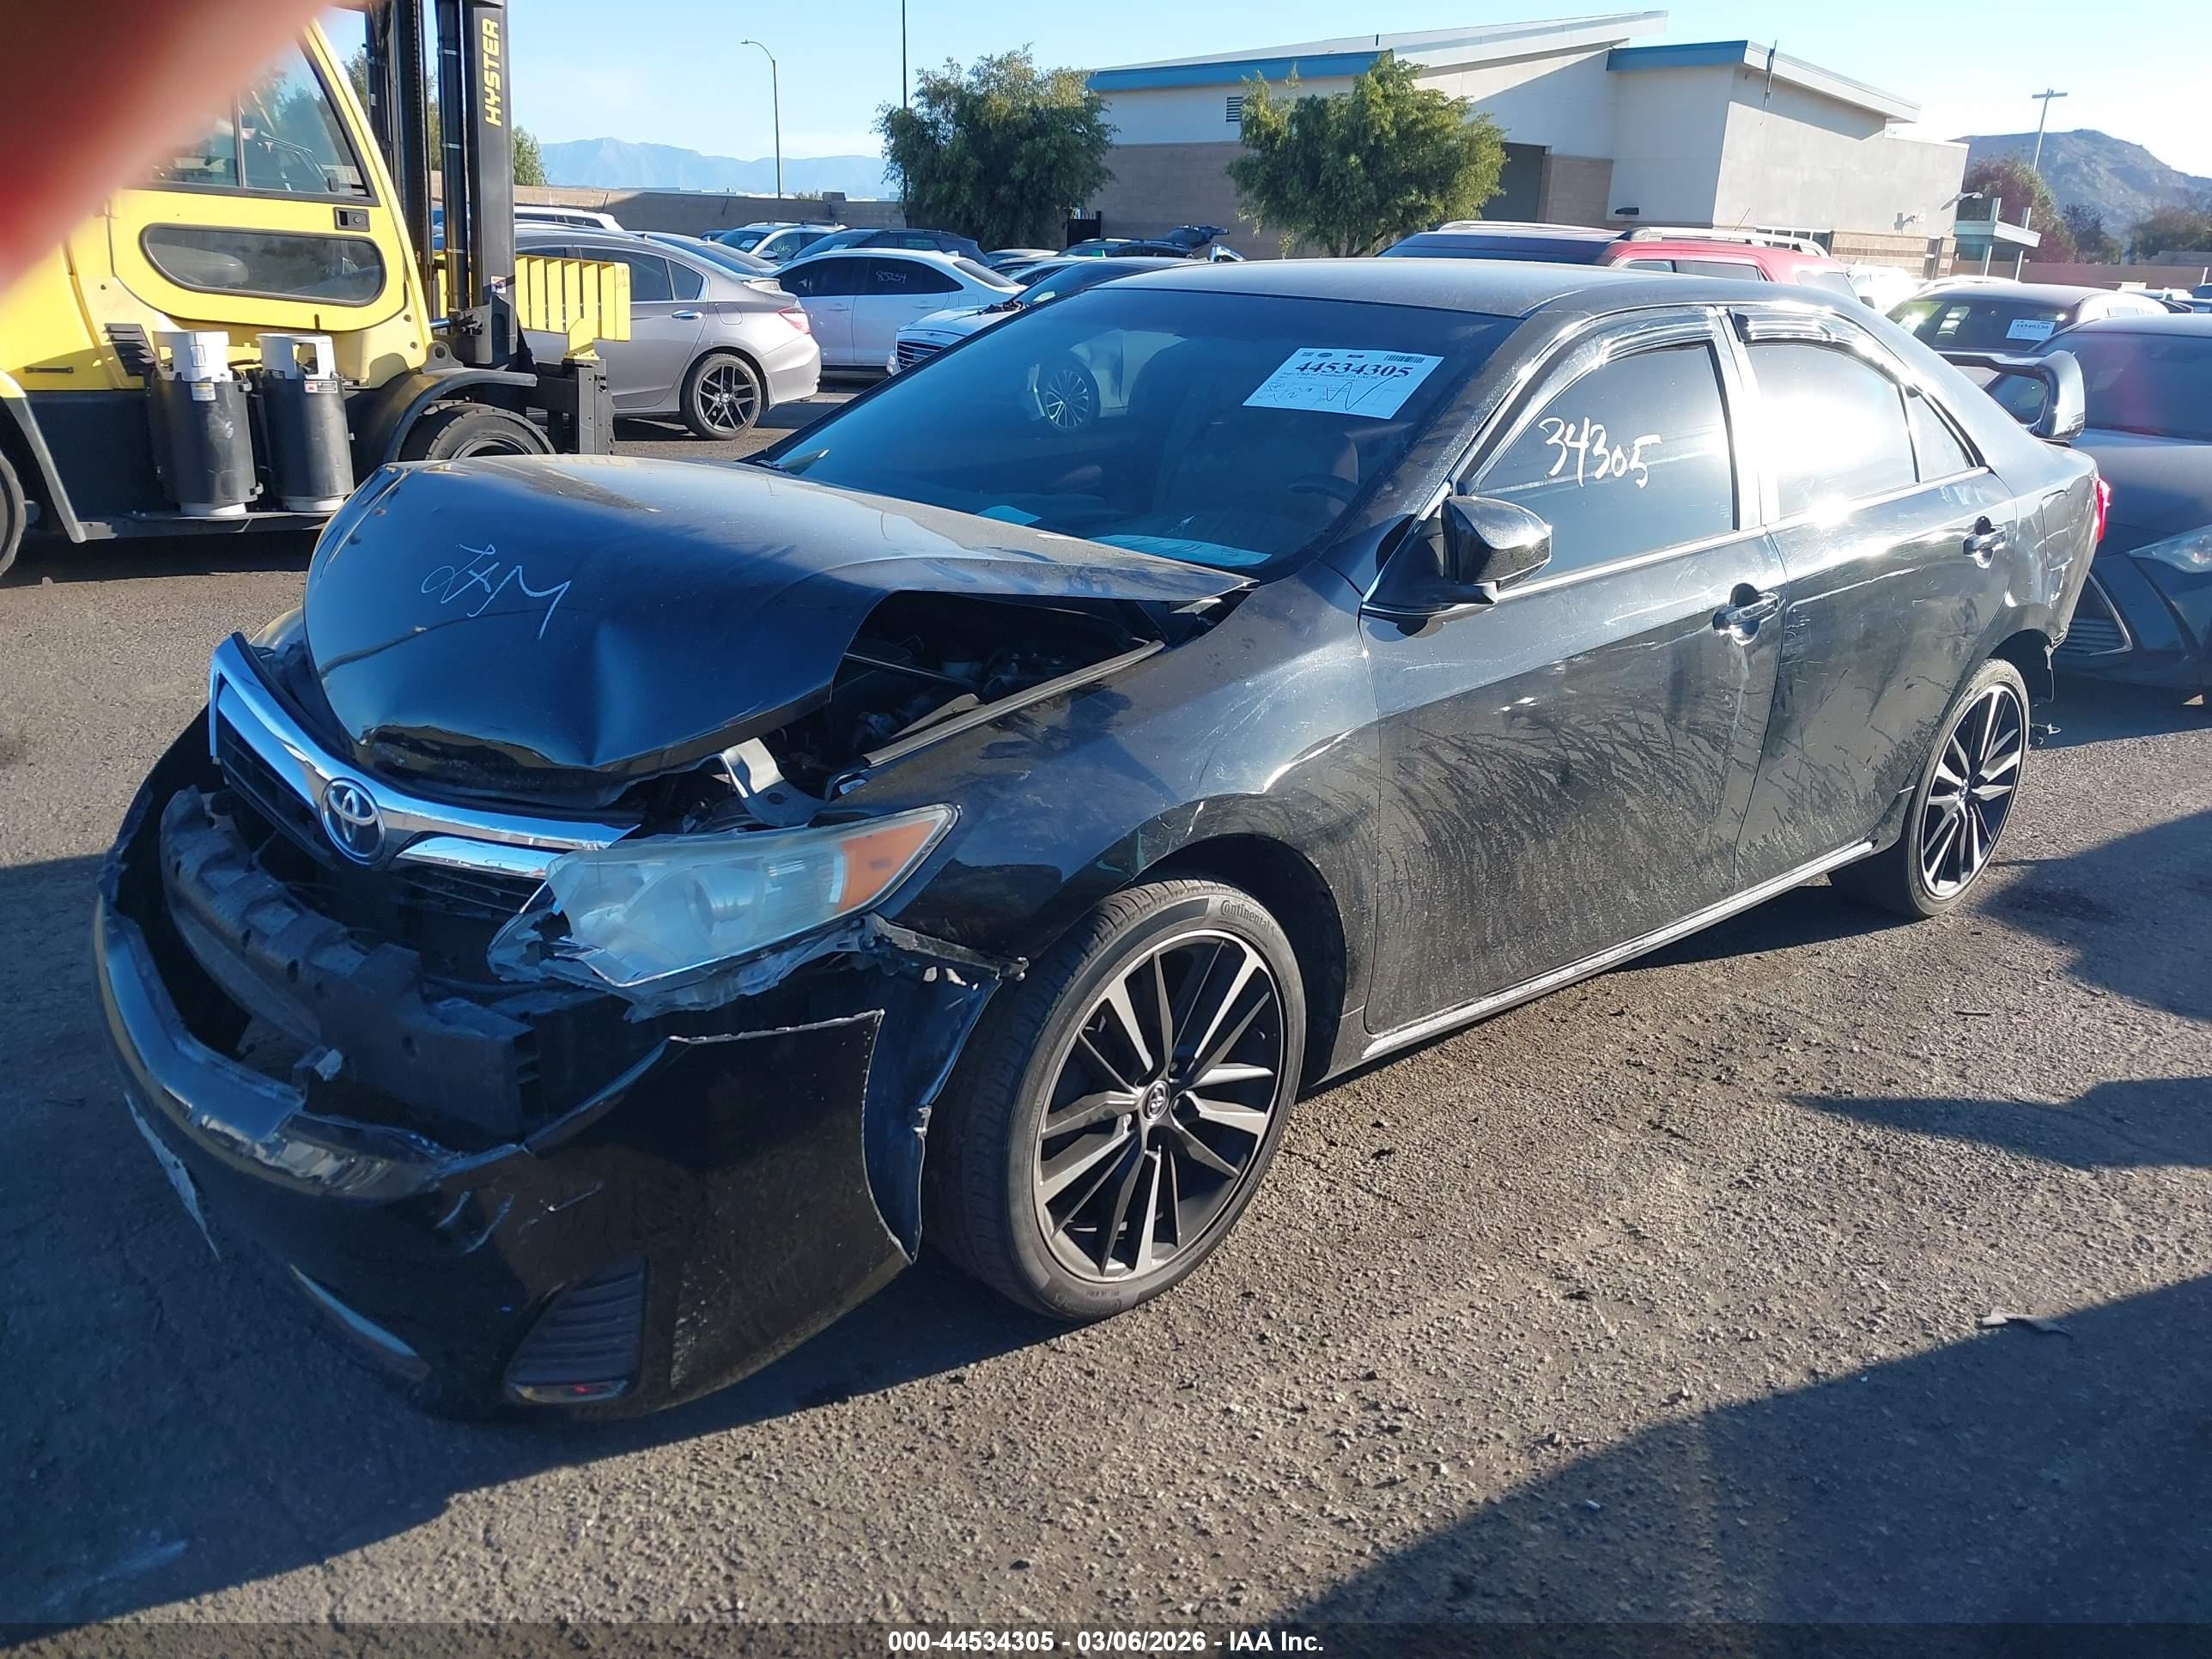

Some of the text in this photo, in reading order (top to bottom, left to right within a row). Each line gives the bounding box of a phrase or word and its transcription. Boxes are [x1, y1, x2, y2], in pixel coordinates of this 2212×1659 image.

[482, 17, 502, 127] HYSTER
[1295, 361, 1415, 378] 44534305
[1539, 416, 1662, 489] 34305
[1220, 900, 1270, 933] Continental
